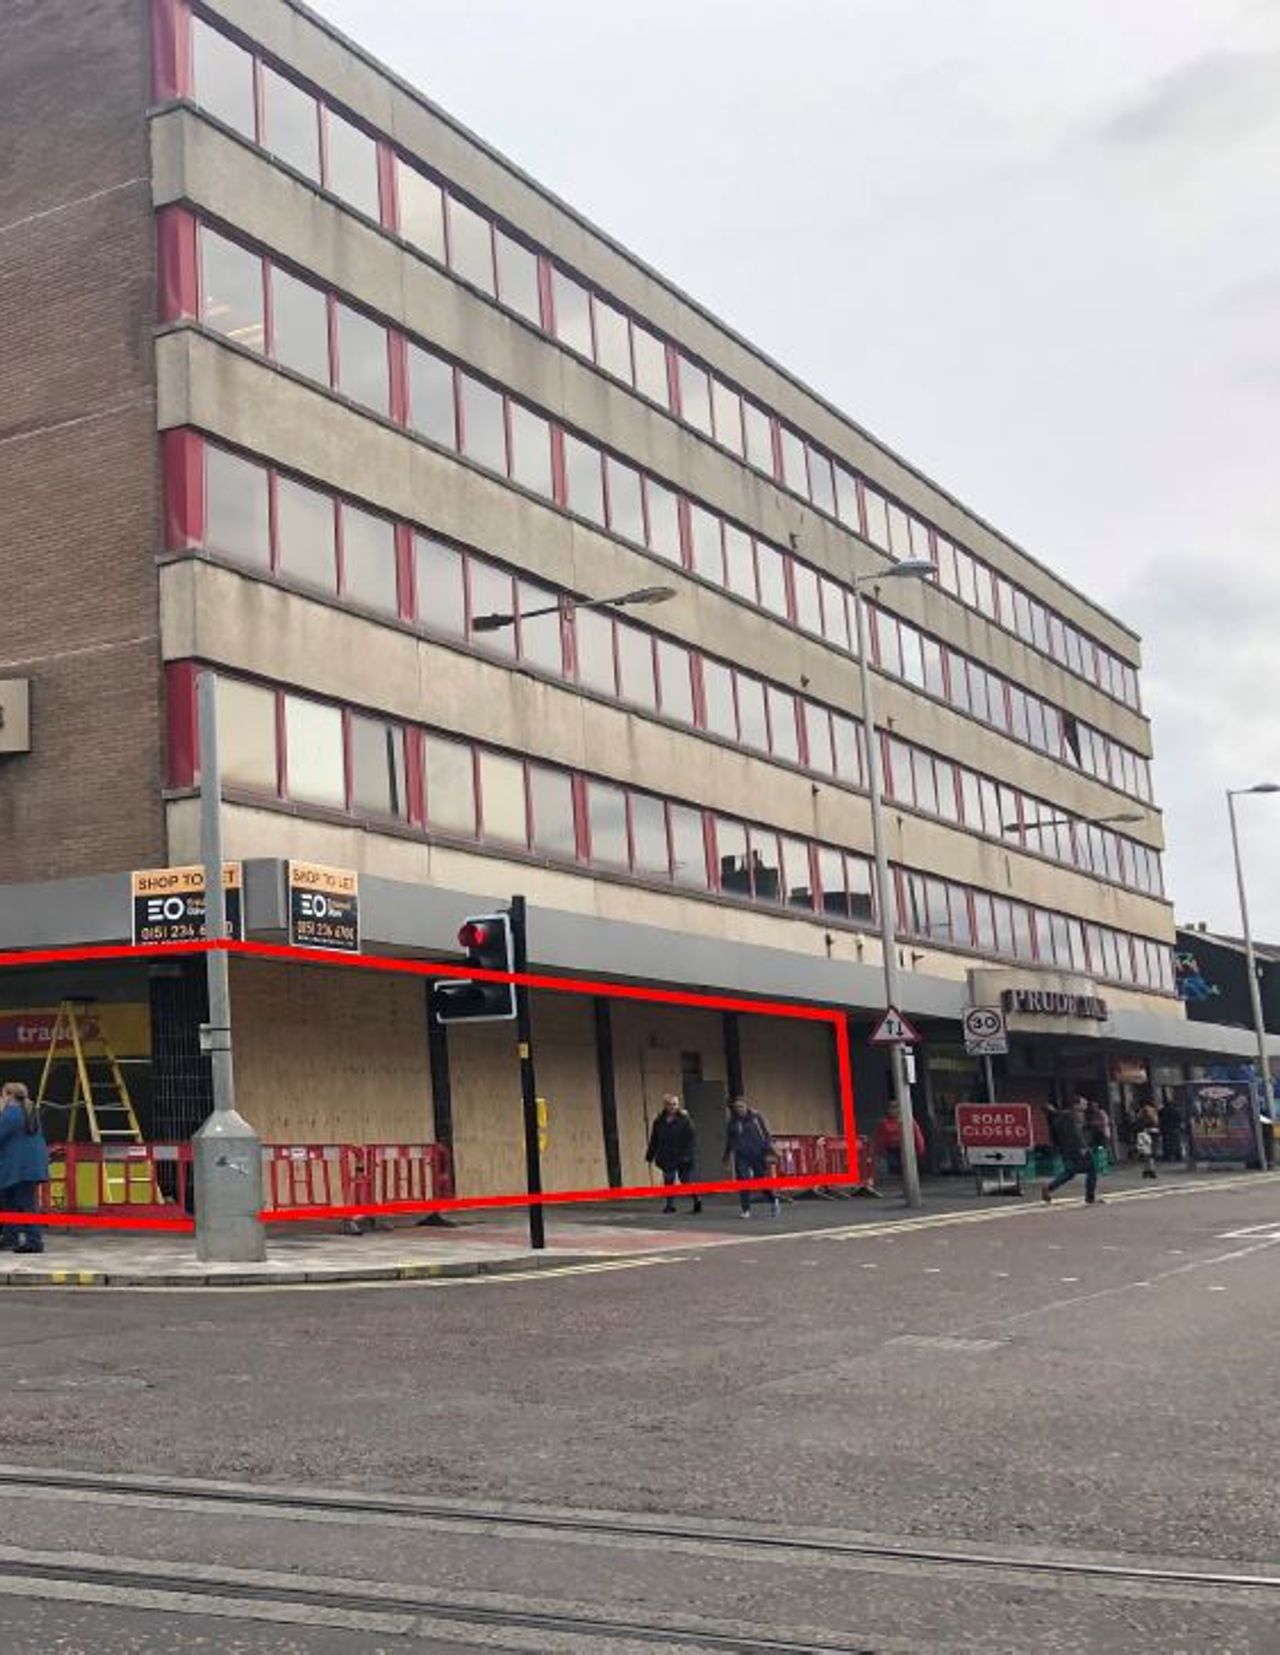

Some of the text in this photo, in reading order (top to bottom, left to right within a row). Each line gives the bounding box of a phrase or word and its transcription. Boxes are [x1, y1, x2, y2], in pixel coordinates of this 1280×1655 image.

[138, 875, 179, 891] SHOP
[182, 872, 204, 887] TO
[147, 896, 185, 921] EO
[972, 1016, 997, 1029] 30
[972, 1113, 1016, 1125] ROAD
[962, 1125, 1027, 1137] CLOSED
